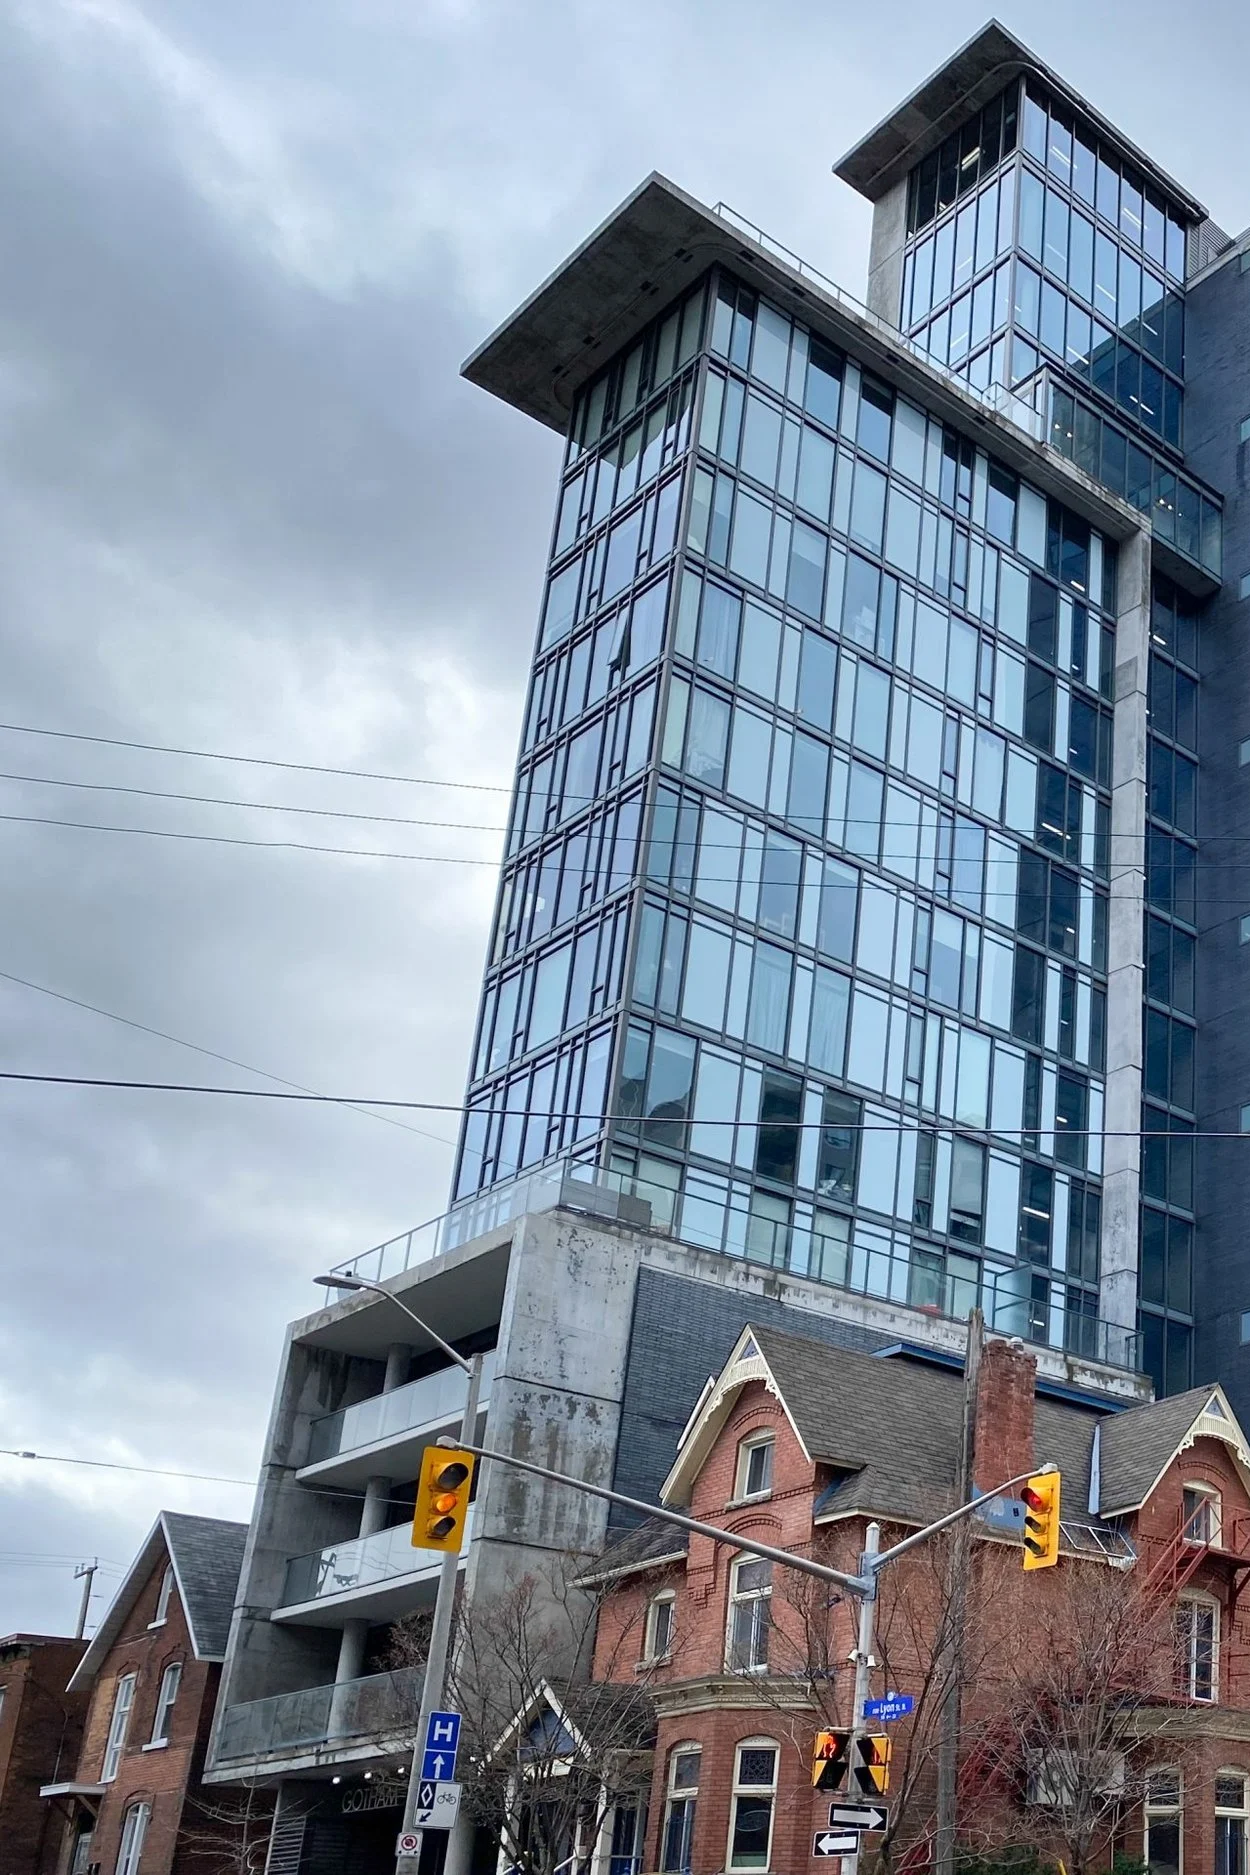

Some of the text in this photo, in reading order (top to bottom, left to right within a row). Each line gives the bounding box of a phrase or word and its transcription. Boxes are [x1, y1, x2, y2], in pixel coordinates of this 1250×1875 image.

[880, 1702, 895, 1716] Lyon
[433, 1720, 454, 1742] H
[342, 1786, 399, 1812] GOTHAM
